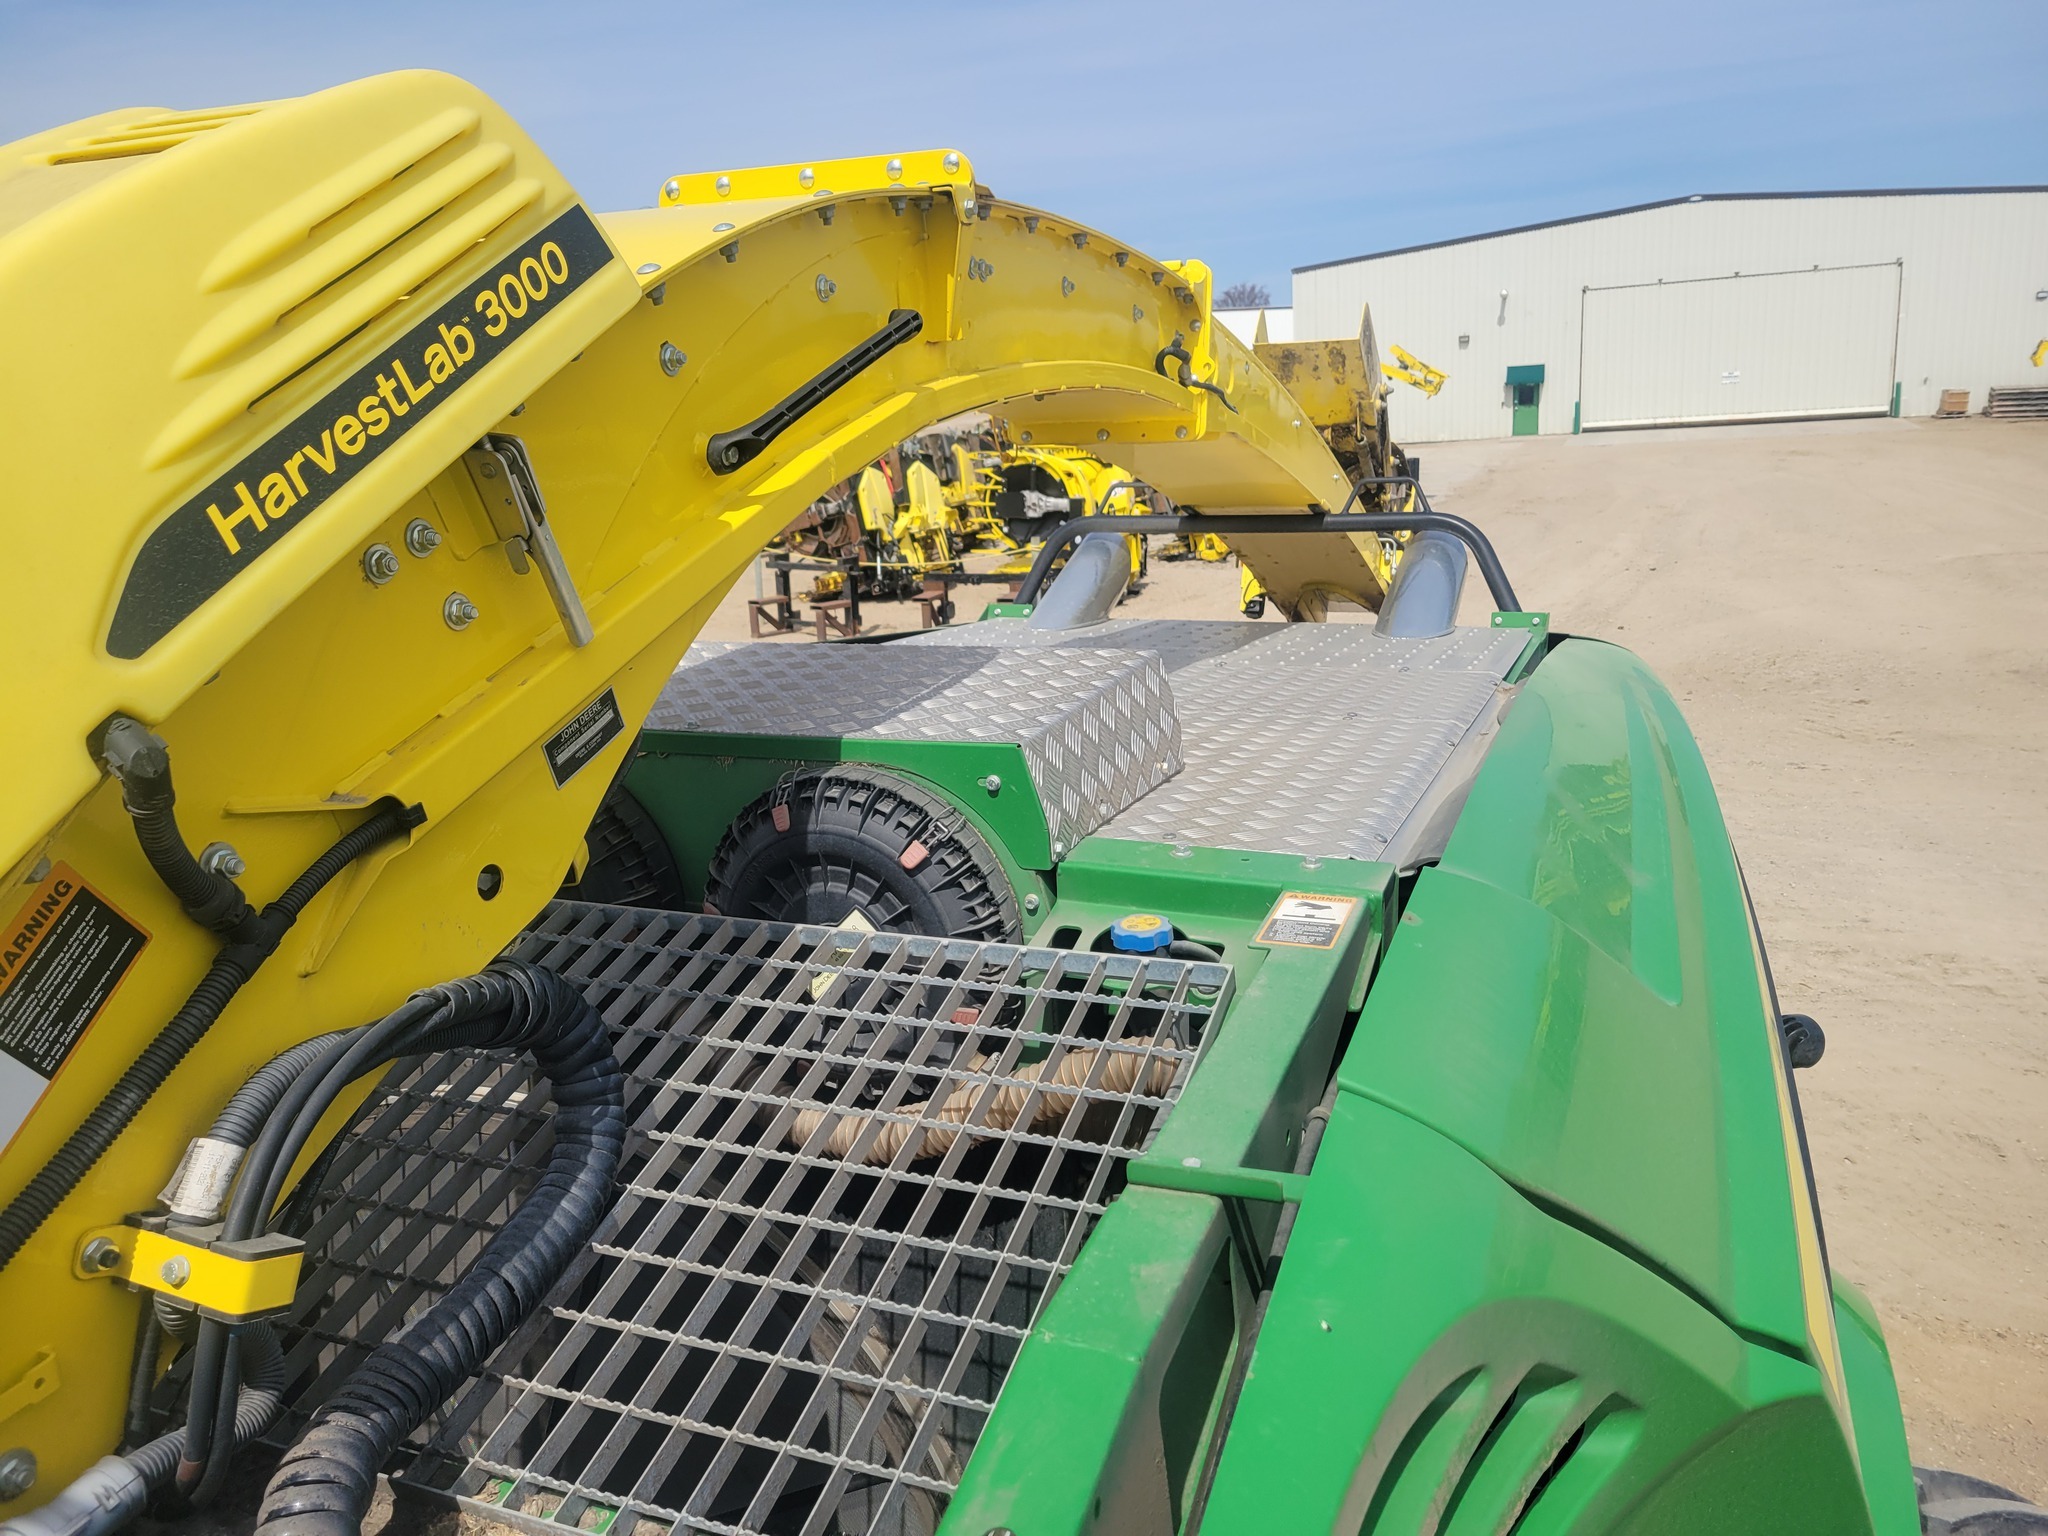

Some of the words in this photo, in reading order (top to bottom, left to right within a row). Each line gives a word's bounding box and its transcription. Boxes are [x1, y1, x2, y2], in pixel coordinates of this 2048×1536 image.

[475, 241, 569, 338] 3000
[554, 731, 580, 756] Component
[580, 719, 594, 733] Serial
[594, 704, 610, 720] Number
[560, 720, 579, 741] JOHN
[579, 700, 601, 724] DEERE
[1301, 894, 1353, 903] WARNING
[3, 1034, 13, 1043] lift
[11, 998, 37, 1034] accumulator
[42, 964, 62, 990] removing
[60, 939, 79, 964] hydraulic
[78, 925, 89, 939] lines
[10, 973, 28, 995] injuries
[26, 959, 38, 973] from
[36, 933, 57, 959] hydraulic
[61, 914, 71, 925] and
[69, 904, 78, 915] gas
[10, 1006, 40, 1047] disassembling
[39, 959, 73, 1006] electro-hydraulic
[71, 944, 83, 958] valve
[82, 927, 95, 944] stack:
[14, 992, 36, 1020] removing,
[34, 951, 64, 991] disassembling
[67, 921, 86, 944] charging
[84, 905, 96, 921] spout
[22, 1030, 35, 1045] Start
[34, 1010, 49, 1030] engine
[48, 998, 57, 1010] and
[56, 982, 69, 999] press
[67, 963, 82, 982] switch
[87, 938, 99, 954] spout
[98, 924, 109, 939] down
[28, 1039, 36, 1048] for
[41, 1006, 59, 1030] seconds
[63, 979, 77, 999] relieve
[76, 959, 91, 979] system
[89, 935, 108, 959] hydraulic
[3, 989, 25, 1017] pressure.
[33, 1026, 52, 1052] pressure
[37, 1041, 49, 1055] Stop
[48, 1021, 63, 1041] engine
[41, 1056, 51, 1067] Use
[50, 1042, 60, 1055] only
[59, 1032, 67, 1042] dry
[66, 1008, 83, 1032] nitrogen
[88, 970, 110, 999] recharging
[109, 937, 133, 970] accumulator.
[46, 1059, 55, 1070] See
[54, 1045, 64, 1059] your
[64, 1028, 76, 1045] JOHN
[74, 1008, 90, 1028] DEERE
[89, 990, 104, 1008] dealer.
